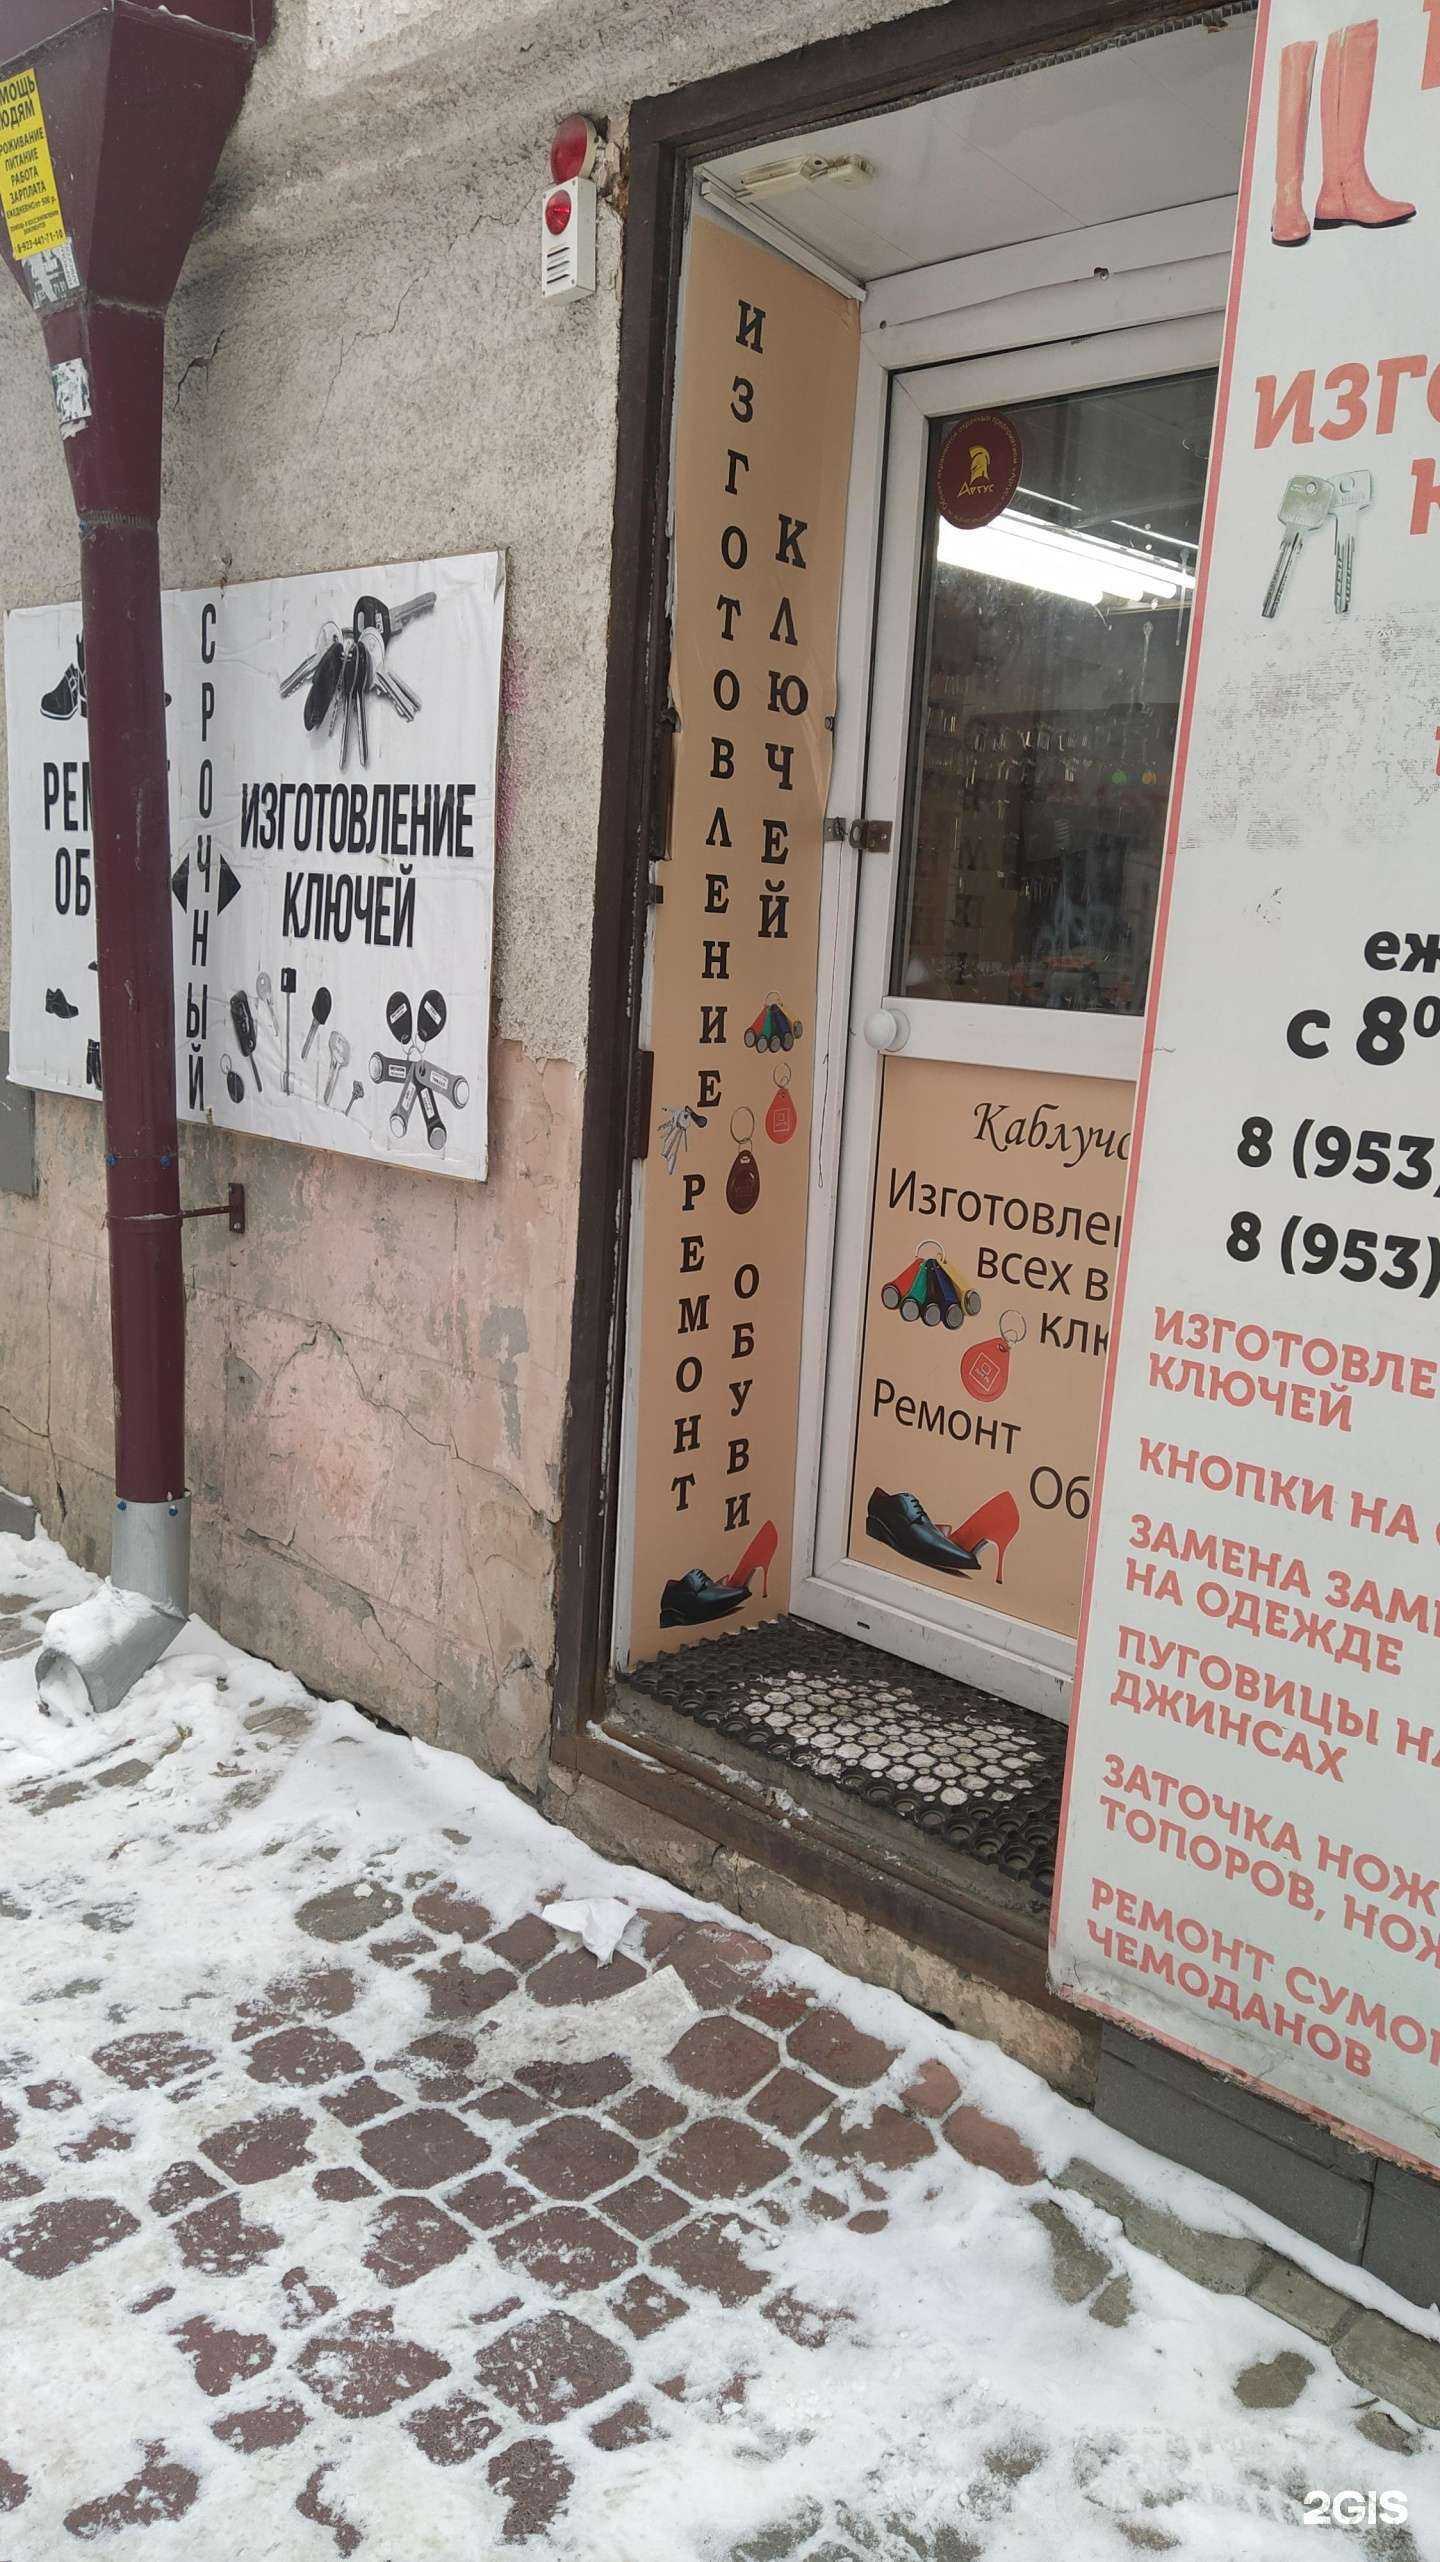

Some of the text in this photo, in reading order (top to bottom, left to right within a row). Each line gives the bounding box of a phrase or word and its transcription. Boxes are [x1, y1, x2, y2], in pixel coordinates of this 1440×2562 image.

[5, 147, 38, 171] ПИТАНИЕ
[10, 181, 47, 204] ЗАРПЛАТА
[11, 166, 39, 186] РАБОТА
[1254, 355, 1440, 449] ИЗГ
[697, 300, 767, 1108] ИЗГОТОВЛЕНИЕ
[758, 513, 808, 938] КЛЮЧЕЙ
[186, 603, 217, 1112] СРОЧНЫЙ
[240, 783, 476, 858] ИЗГОТОВЛЕНИЕ
[282, 864, 417, 948] КЛЮЧЕЙ
[1286, 1009, 1331, 1059] с
[1237, 1116, 1440, 1198] 8 (953
[977, 1247, 1072, 1296] всех
[1226, 1211, 1262, 1262] 8
[671, 1174, 709, 1512] РЕМОНТ
[1148, 1352, 1353, 1432] КЛЮЧЕЙ
[724, 1263, 760, 1533] ОБУВИ
[874, 1378, 1022, 1455] Ремонт
[1139, 1437, 1419, 1545] КНОПКИ НА
[1126, 1557, 1404, 1676] НА ОДЕЖДЕ
[1129, 1513, 1440, 1638] ЗАМЕНА ЗАМ
[1110, 1670, 1348, 1783] ДЖИНСАХ
[1118, 1625, 1440, 1769] ПУГОВИЦЫ Н
[1099, 1795, 1325, 1921] ТОПОРОВ,
[1103, 1754, 1302, 1861] ЗАТОЧКА
[1087, 1919, 1373, 2079] ЧЕМОДАНОВ
[1091, 1877, 1440, 2067] РЕМОНТ СУМО
